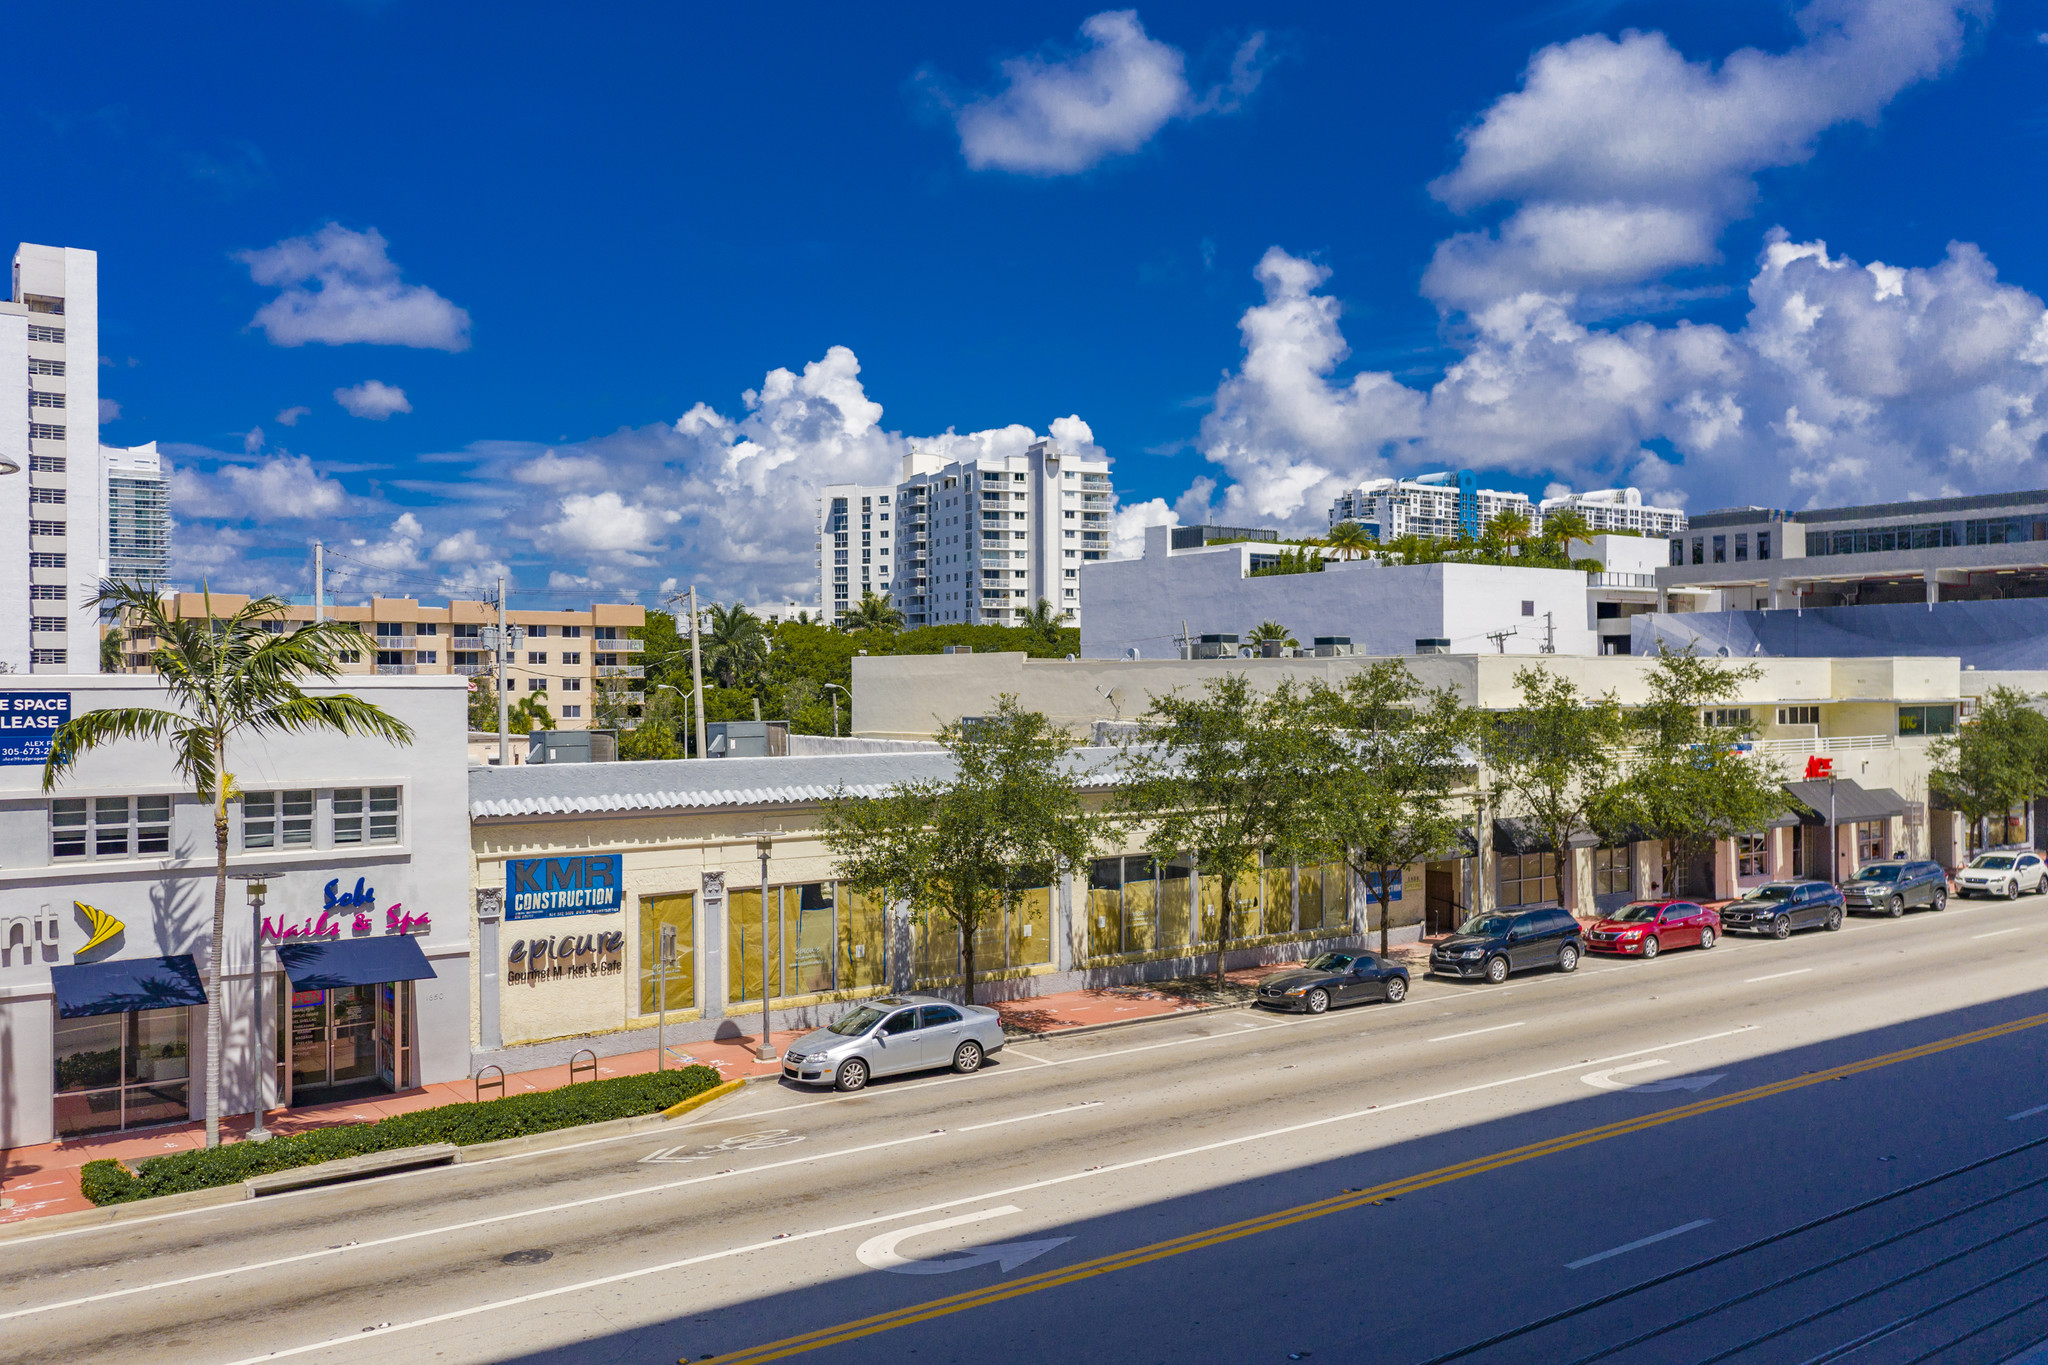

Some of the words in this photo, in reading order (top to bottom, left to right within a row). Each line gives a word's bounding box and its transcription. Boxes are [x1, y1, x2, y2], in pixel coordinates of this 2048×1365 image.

[14, 698, 68, 711] SPACE
[0, 716, 59, 728] LEASE
[1803, 755, 1833, 778] ACE
[515, 856, 614, 892] KMR
[323, 876, 375, 910] Sobe
[515, 888, 613, 911] CONSTRUCTION
[261, 911, 341, 940] Nails
[352, 913, 373, 932] &
[386, 903, 432, 936] Spa
[508, 930, 625, 971] epicure
[508, 967, 551, 982] Gourmet
[553, 963, 588, 977] Mrket
[591, 962, 598, 973] &
[601, 959, 622, 972] Cafe
